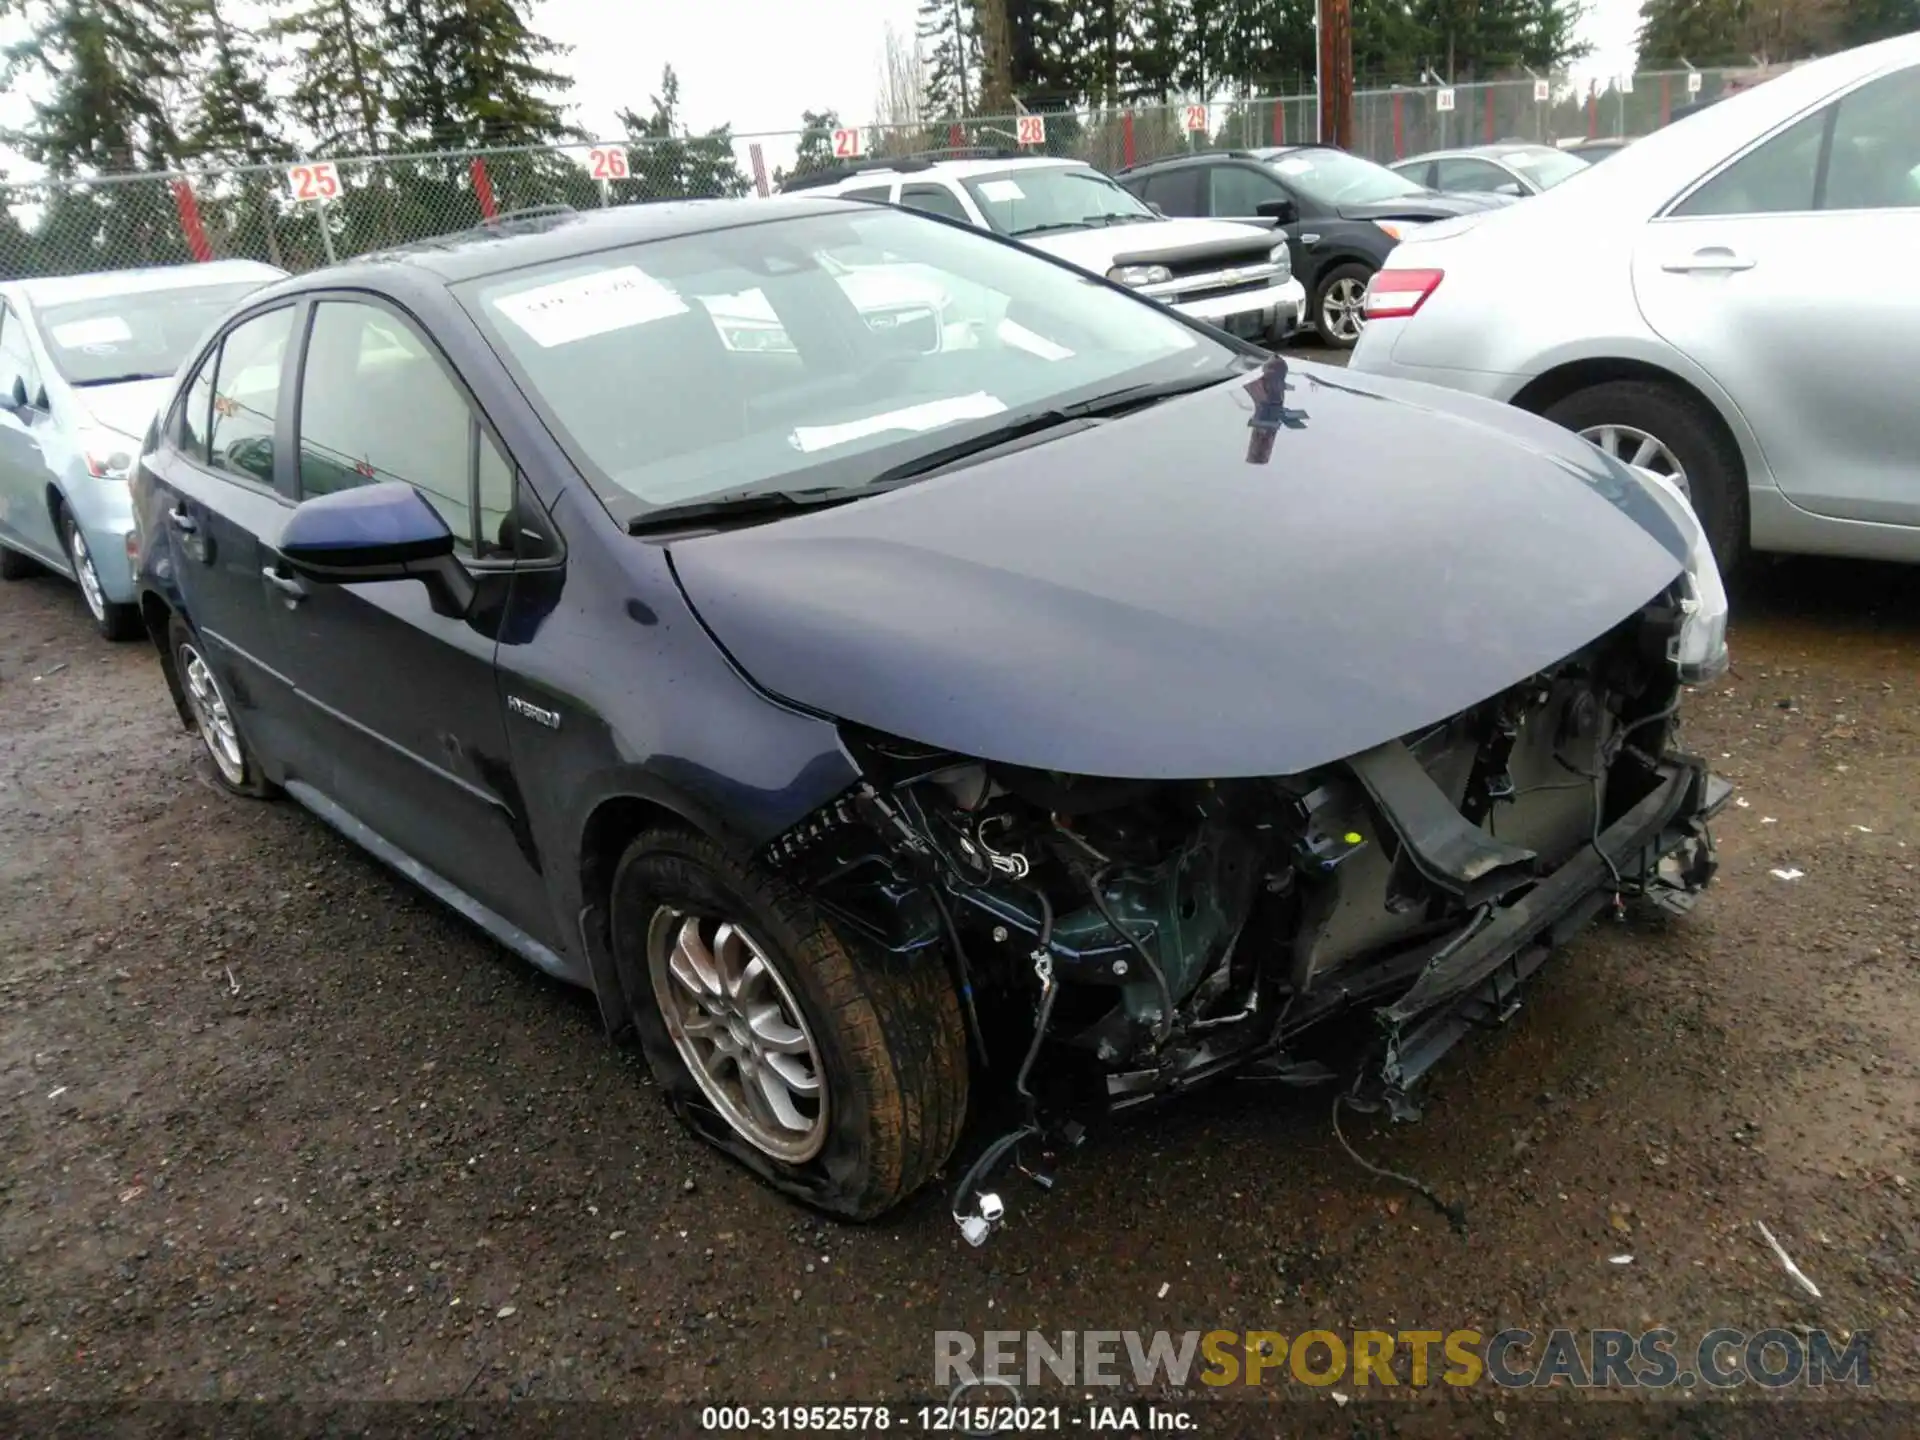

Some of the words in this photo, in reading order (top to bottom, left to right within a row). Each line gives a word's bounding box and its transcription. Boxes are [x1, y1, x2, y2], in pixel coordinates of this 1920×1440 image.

[1019, 118, 1042, 142] 28
[1187, 106, 1207, 129] 29
[835, 129, 859, 156] 27
[589, 148, 626, 177] 26
[292, 164, 338, 198] 25
